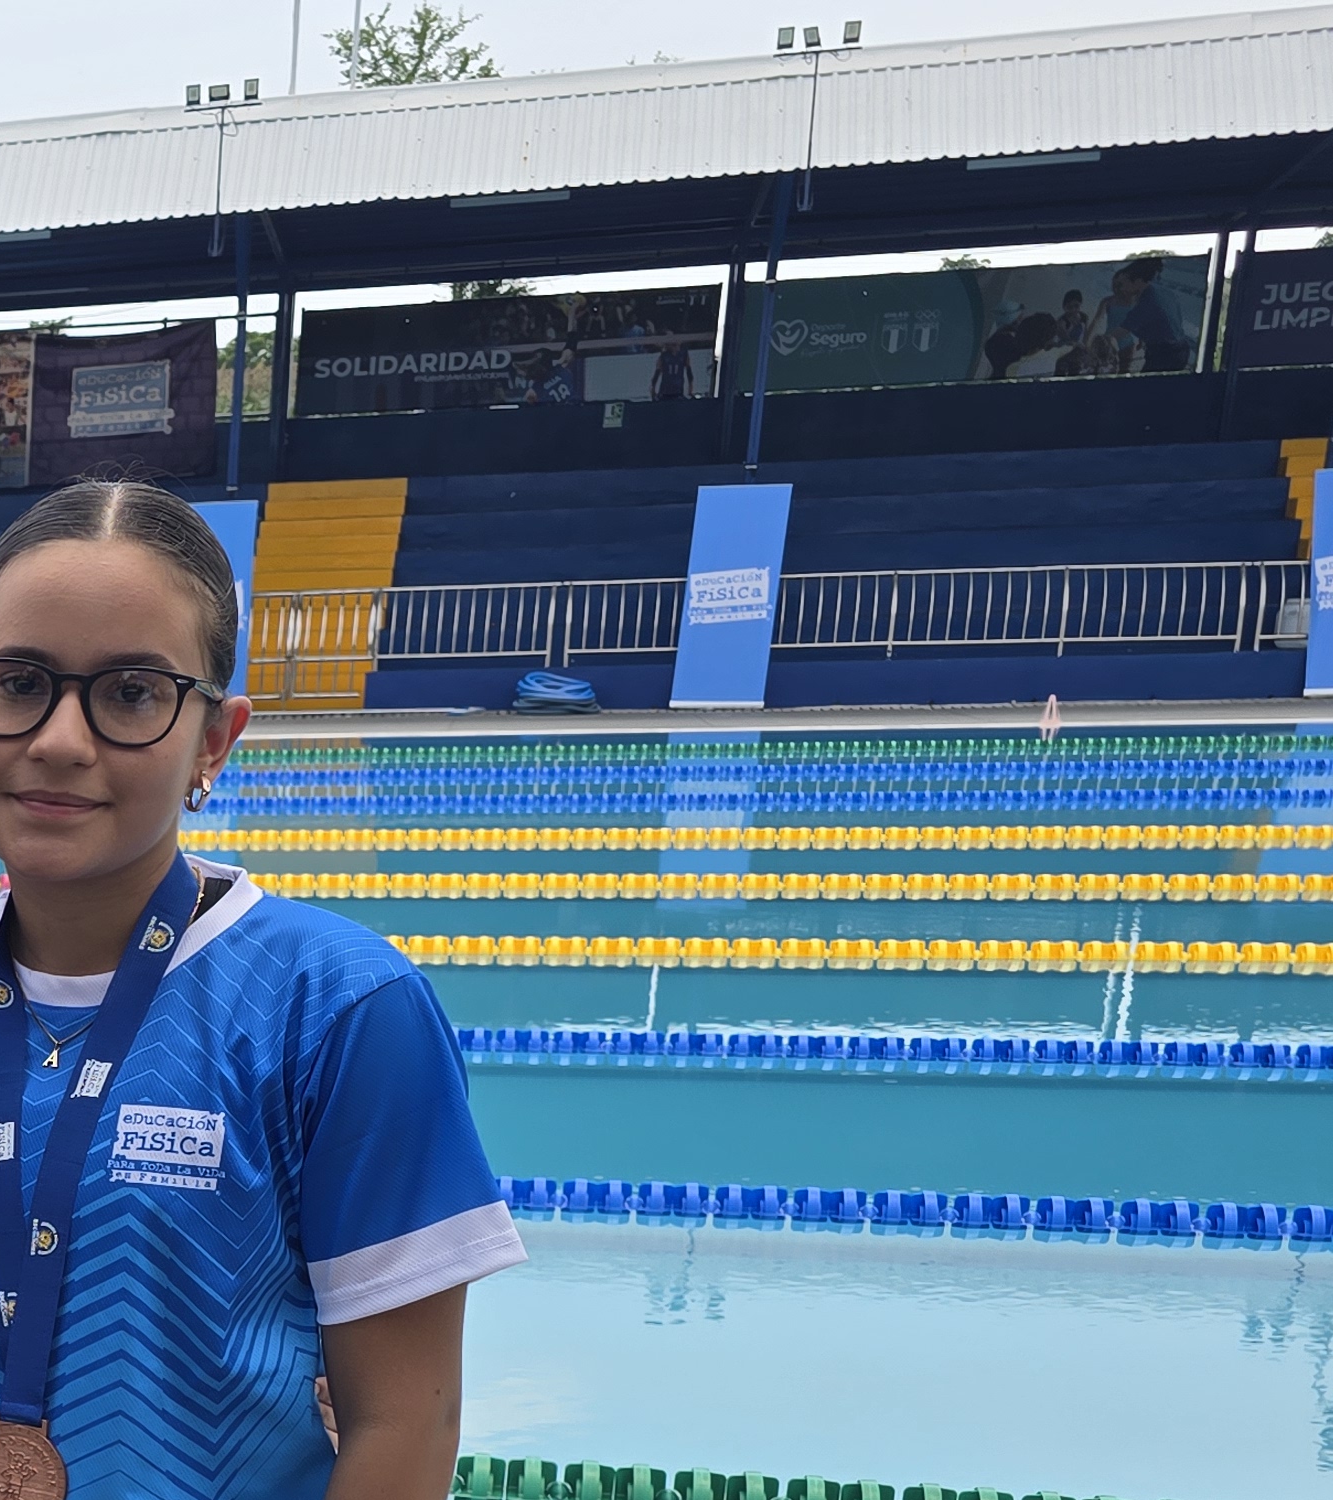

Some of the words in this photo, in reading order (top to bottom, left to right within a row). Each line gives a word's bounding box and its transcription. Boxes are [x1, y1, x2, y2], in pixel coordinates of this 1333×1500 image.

[809, 332, 867, 348] Seguro
[314, 350, 512, 378] SOLIDARIDAD
[122, 1113, 218, 1131] eDuCaCióN
[120, 1130, 216, 1158] FíSiCa
